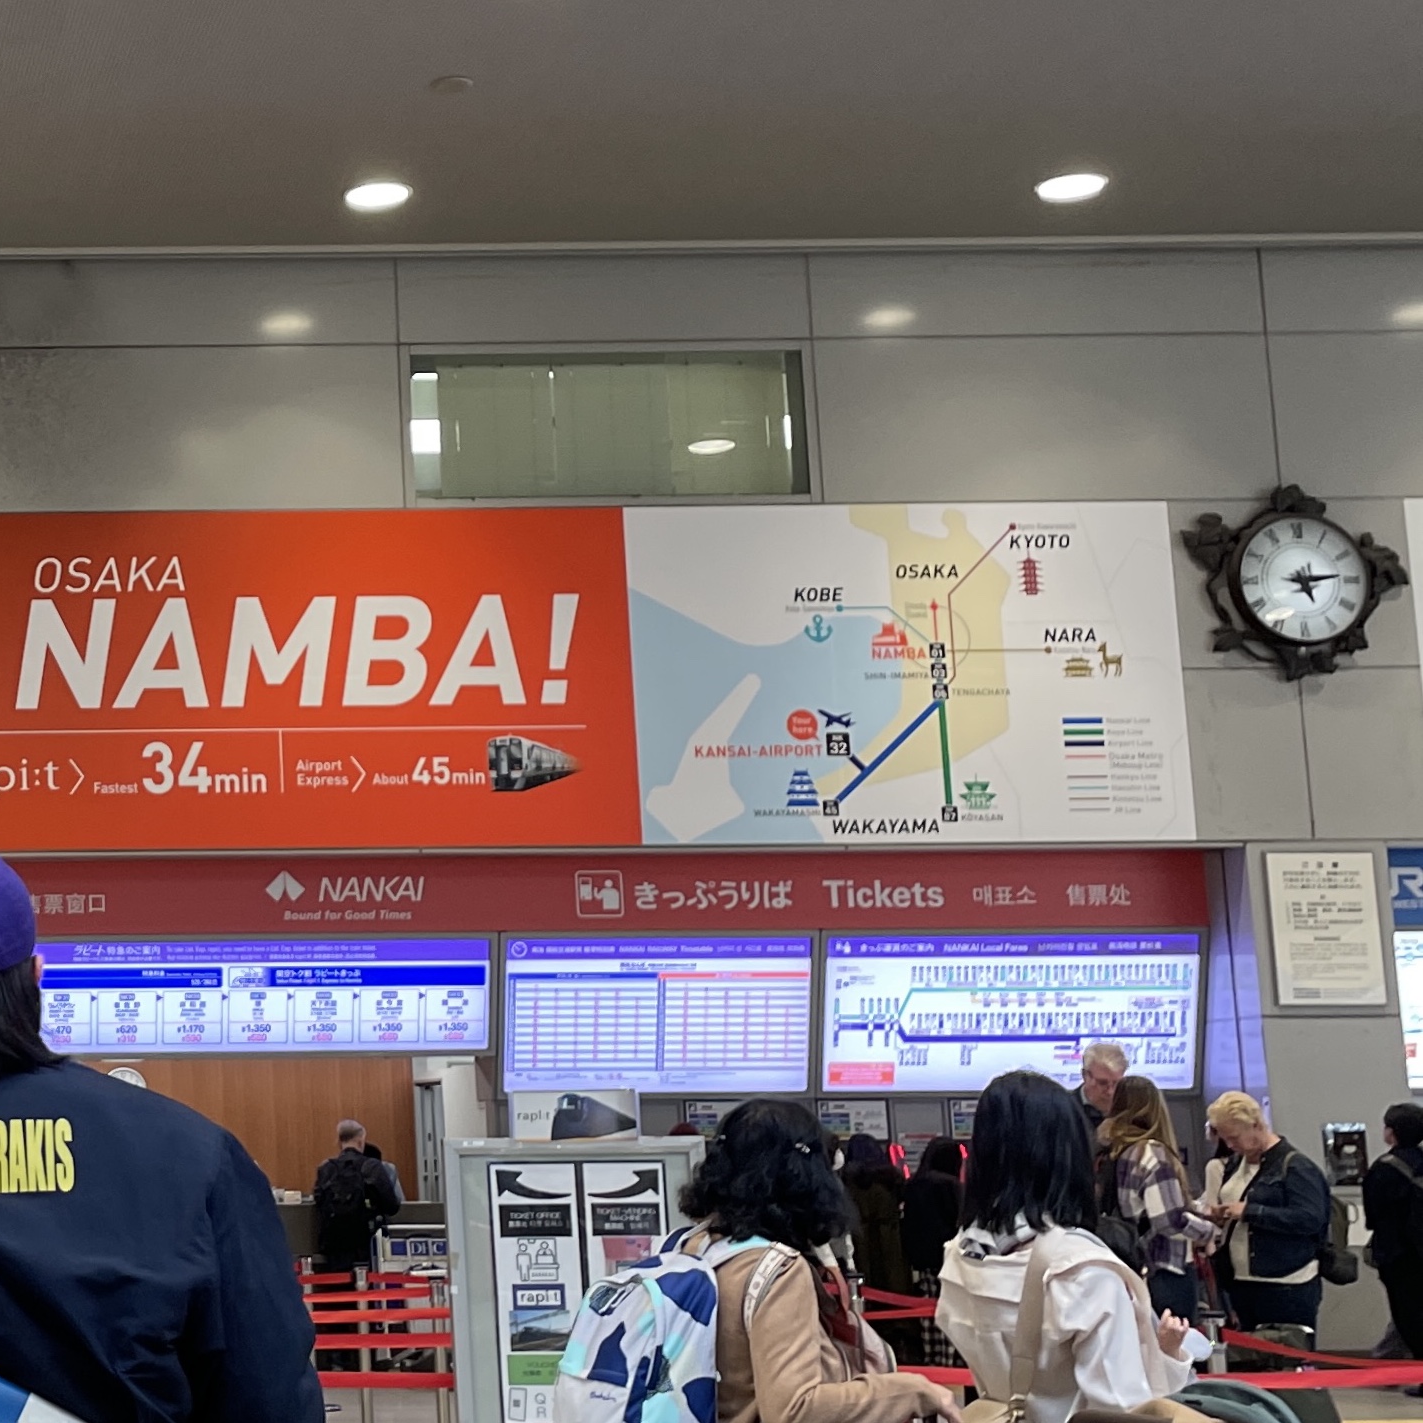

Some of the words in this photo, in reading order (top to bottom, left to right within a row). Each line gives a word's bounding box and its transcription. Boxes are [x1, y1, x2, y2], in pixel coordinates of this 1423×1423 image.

[1009, 534, 1070, 549] KYOTO
[34, 556, 186, 593] OSAKA
[896, 564, 959, 579] OSAKA
[794, 587, 843, 602] KOBE
[1044, 627, 1096, 642] NARA
[15, 593, 579, 710] NAMBA!
[872, 647, 927, 660] NAMBA
[931, 649, 944, 658] 01
[694, 744, 823, 758] KANSAI-AIRPORT
[829, 742, 848, 754] 32
[93, 781, 138, 794] Fastest
[141, 741, 267, 795] 34min
[296, 759, 342, 773] Airport
[373, 773, 409, 786] About
[412, 756, 486, 786] 45min
[296, 773, 349, 788] Express
[832, 819, 940, 834] WAKAYAMA
[318, 876, 425, 902] NANKAI
[634, 880, 792, 910] きっぷうりば
[822, 879, 945, 909] Tickets
[973, 884, 1037, 906] 매표소
[1066, 884, 1131, 907] 售票处
[284, 910, 320, 920] Bound
[323, 909, 341, 920] for
[344, 909, 377, 920] Good
[379, 909, 412, 920] Times
[510, 1211, 535, 1219] TICKET
[535, 1211, 561, 1219] OFFICE
